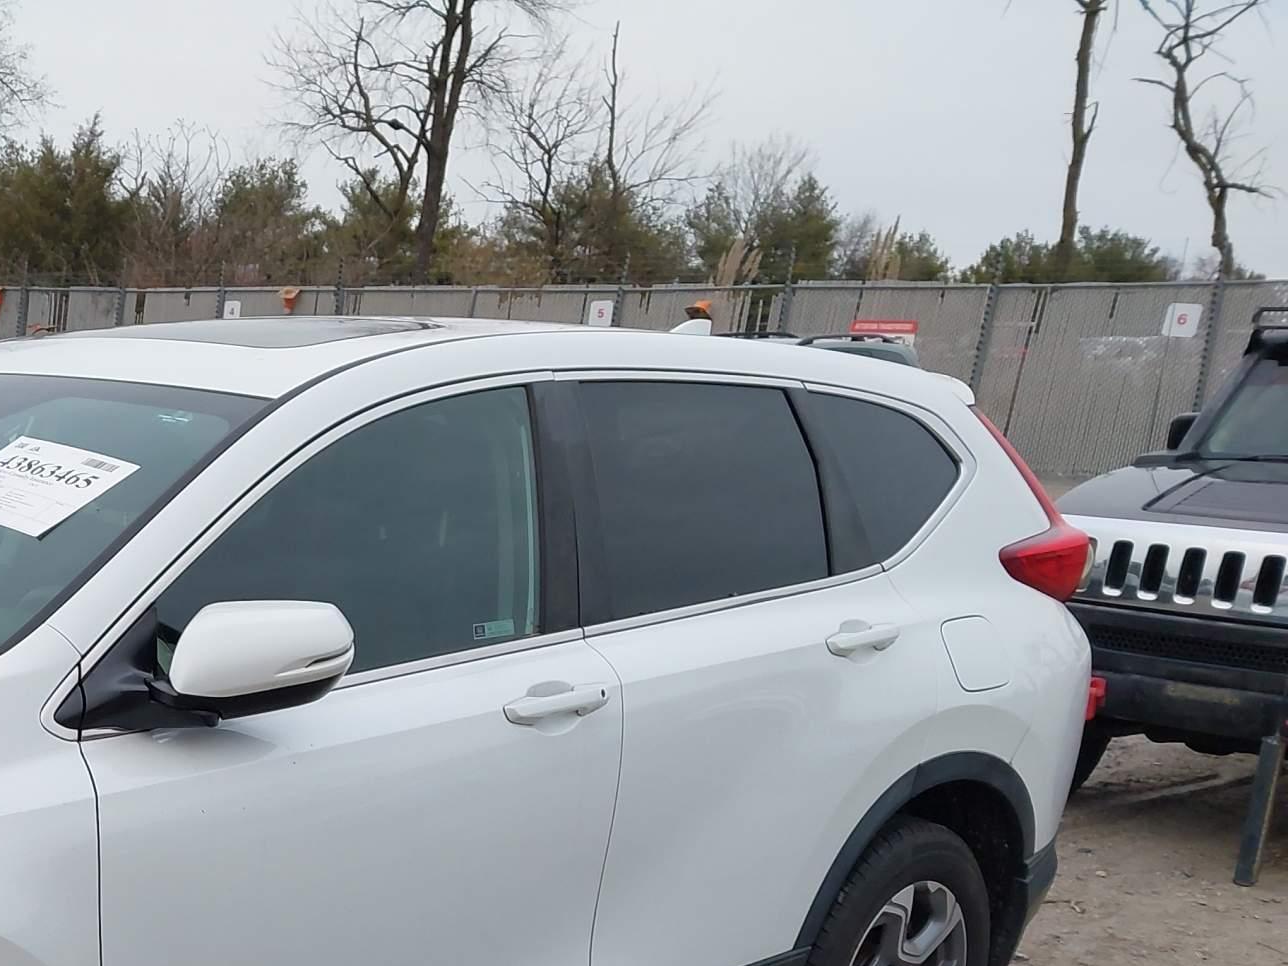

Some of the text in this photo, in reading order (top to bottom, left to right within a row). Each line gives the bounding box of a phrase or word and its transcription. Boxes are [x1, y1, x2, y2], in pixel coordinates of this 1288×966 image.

[597, 308, 605, 318] 5
[1177, 313, 1189, 325] 6
[0, 455, 100, 489] 43863465
